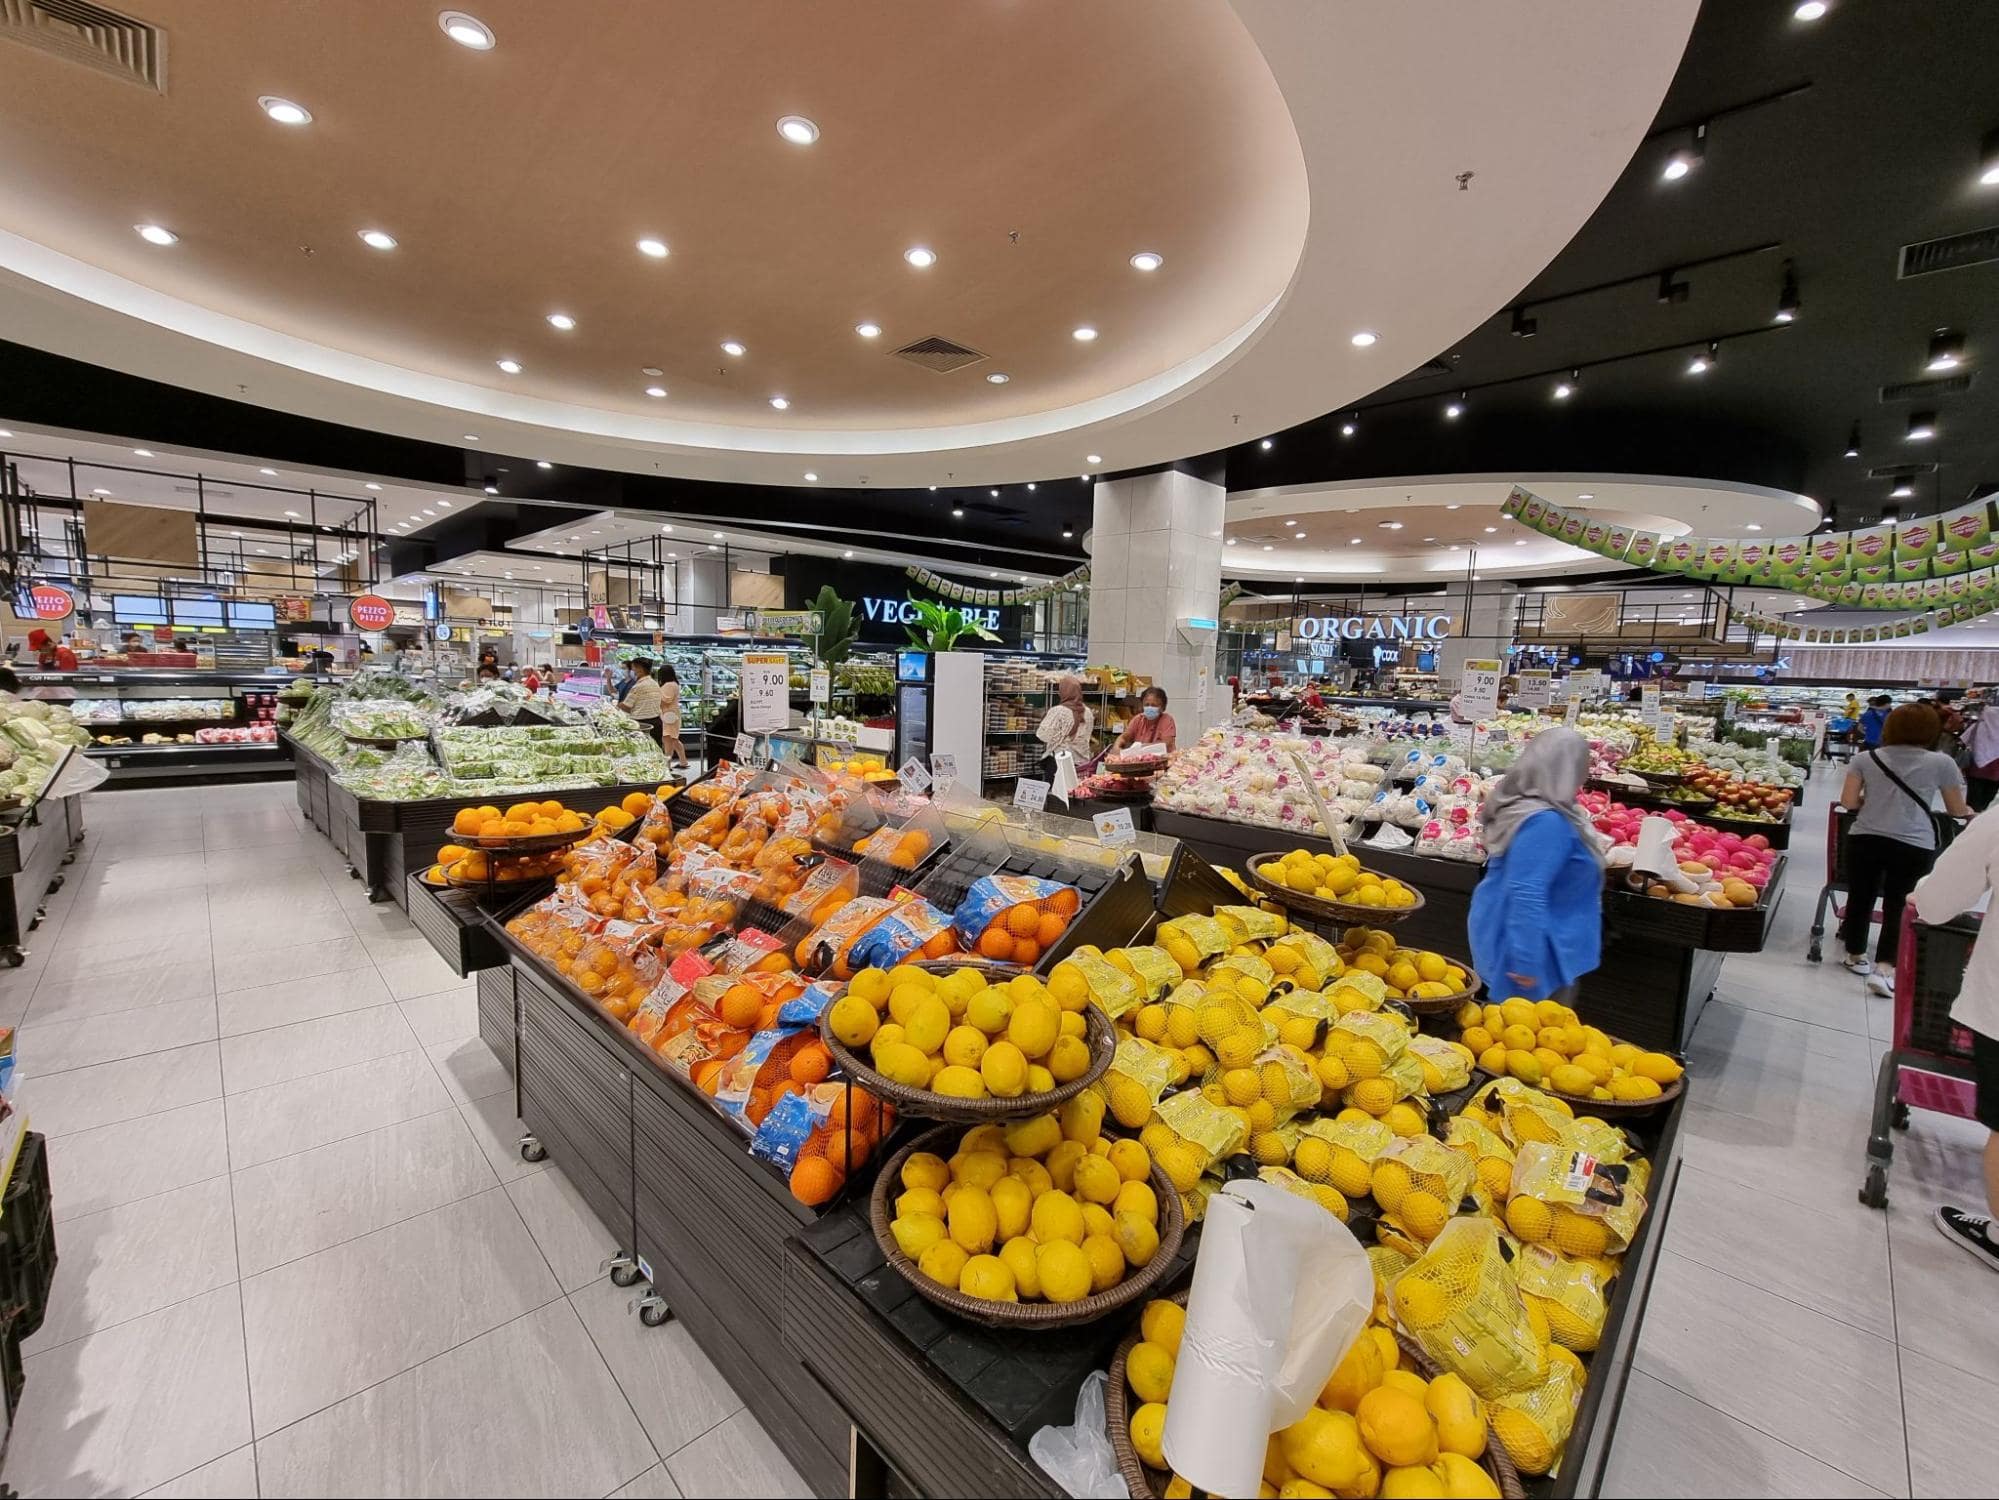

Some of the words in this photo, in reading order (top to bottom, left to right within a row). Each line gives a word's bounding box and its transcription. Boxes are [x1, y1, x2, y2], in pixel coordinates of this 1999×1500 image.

[357, 605, 387, 615] PEZZO
[359, 614, 386, 622] PIZZA
[1299, 616, 1450, 639] ORGANIC
[763, 674, 784, 685] 9.00
[1477, 676, 1495, 686] 9.00
